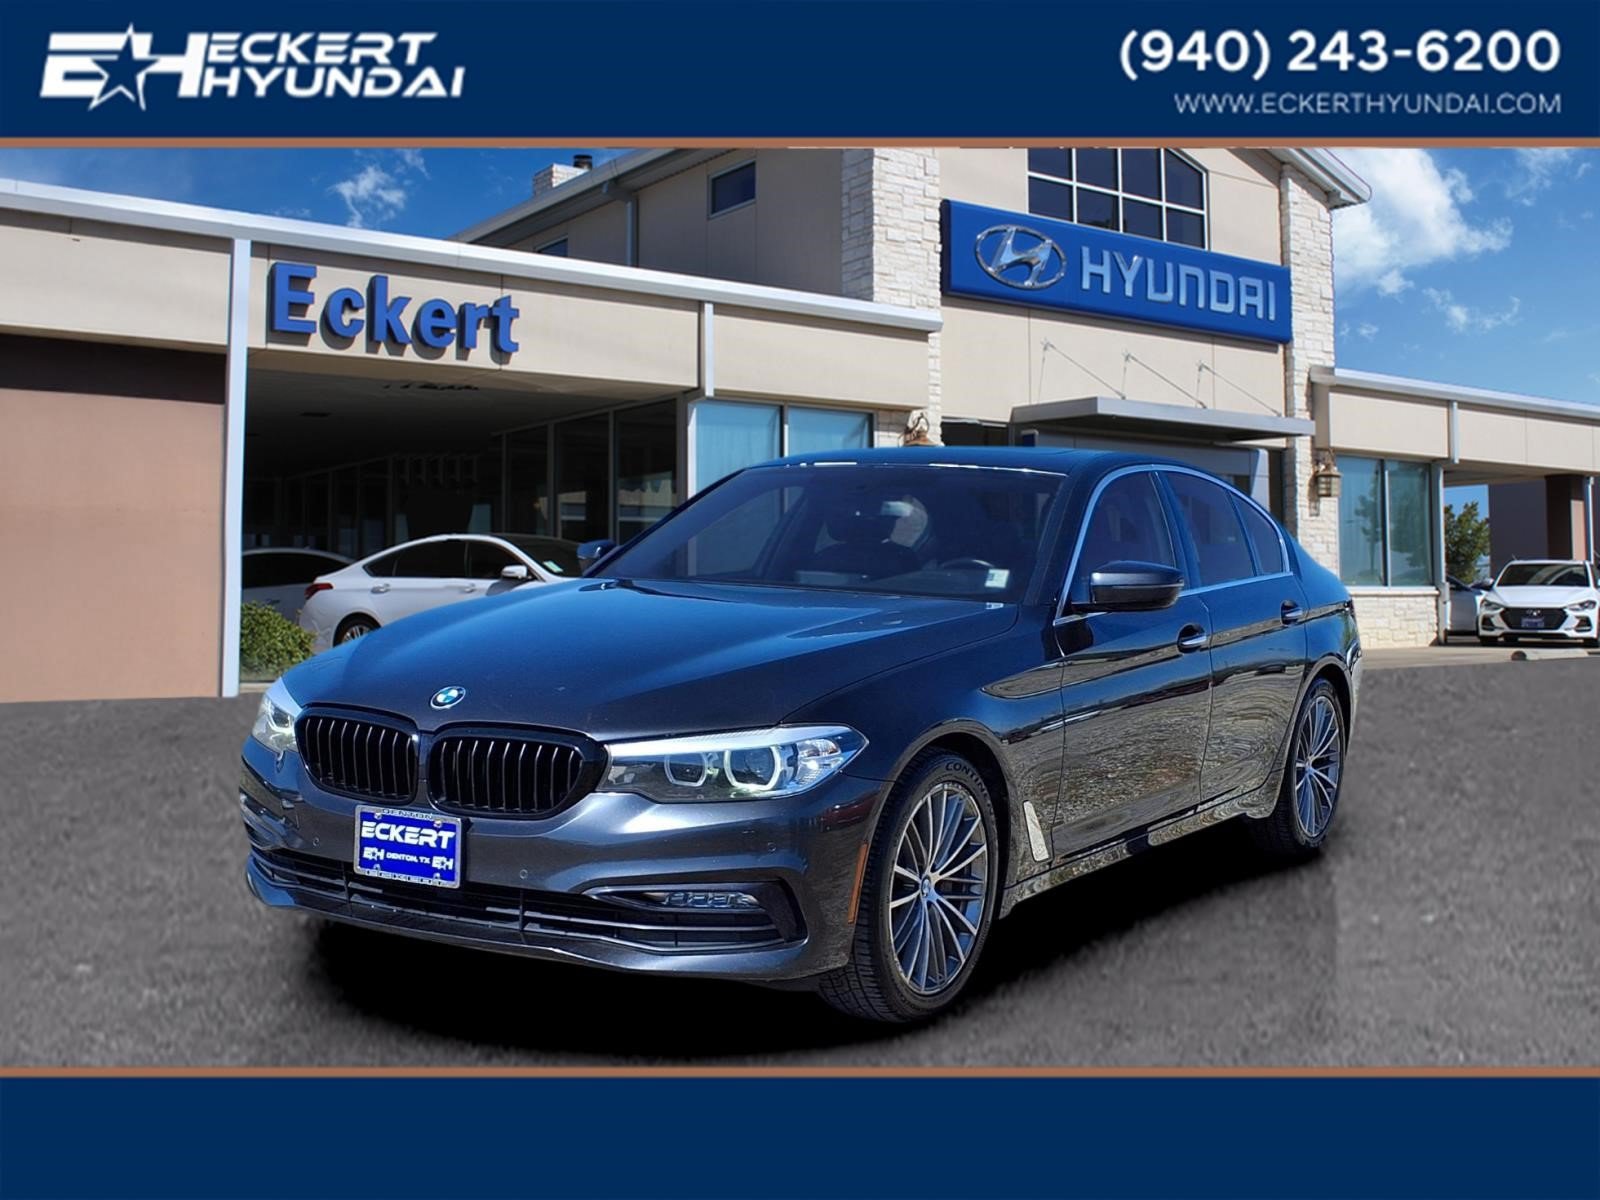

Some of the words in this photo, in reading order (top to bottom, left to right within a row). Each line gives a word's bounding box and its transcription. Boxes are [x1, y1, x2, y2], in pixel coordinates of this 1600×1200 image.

[269, 262, 519, 353] Eckert
[1081, 246, 1277, 321] HYUNDAI
[361, 821, 456, 849] ECKERT
